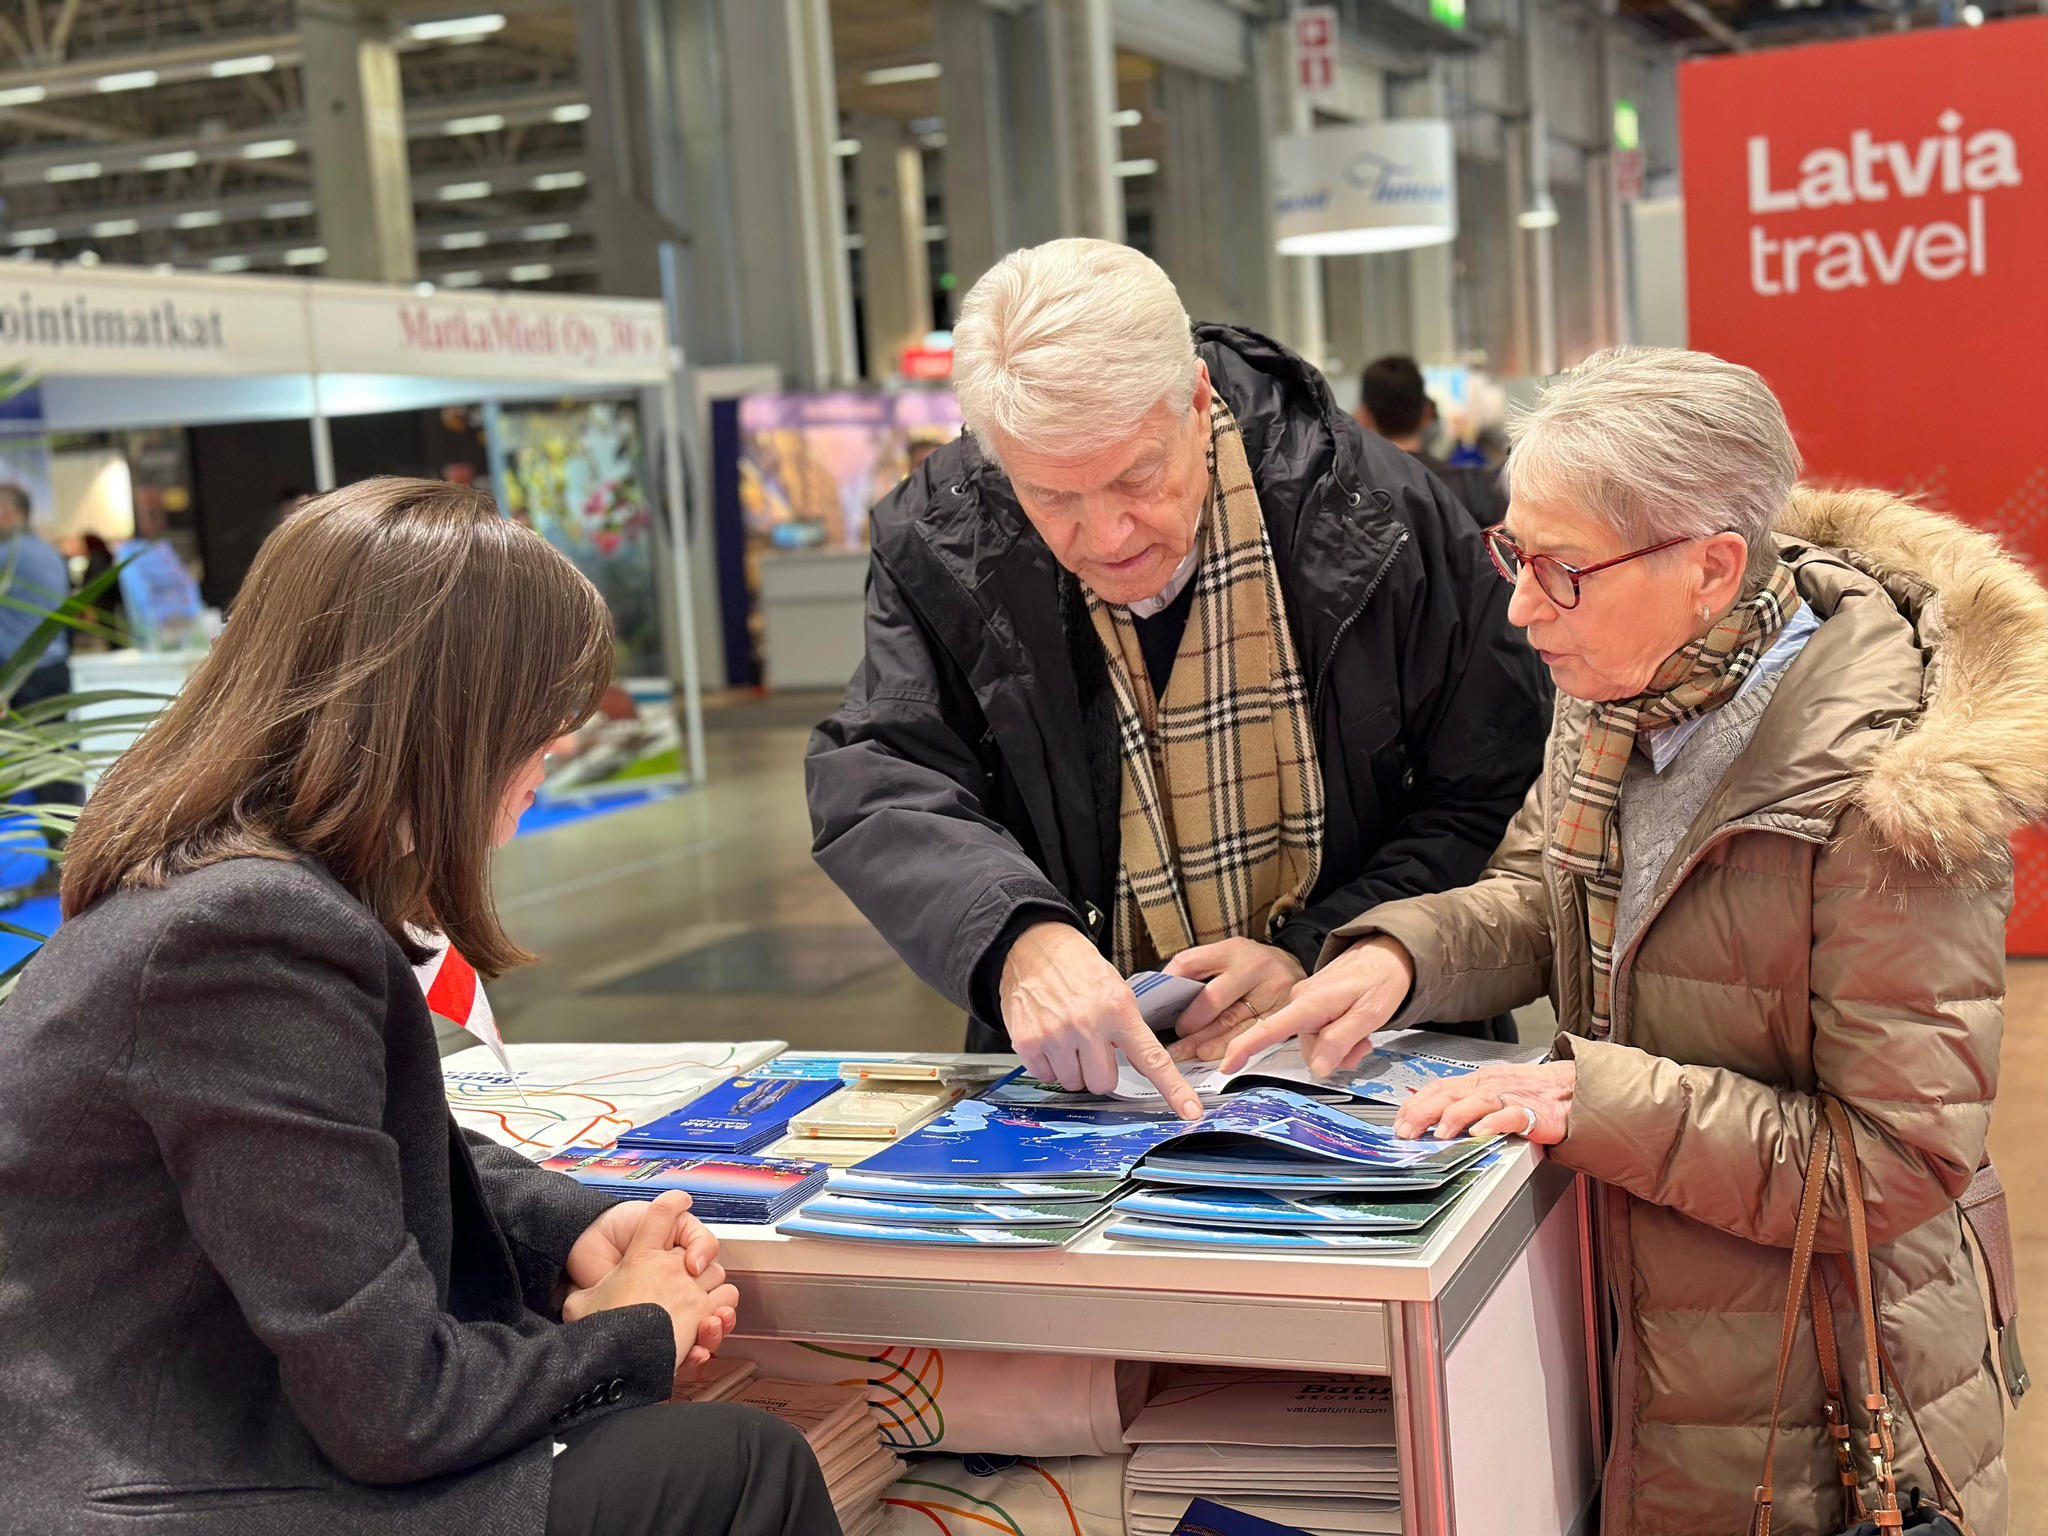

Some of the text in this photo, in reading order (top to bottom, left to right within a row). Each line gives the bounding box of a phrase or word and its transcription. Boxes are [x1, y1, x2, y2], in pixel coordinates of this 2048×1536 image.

[1748, 108, 2021, 213] Latvia
[1750, 194, 1986, 296] travel
[1286, 1406, 1388, 1414] visitbatumi.com
